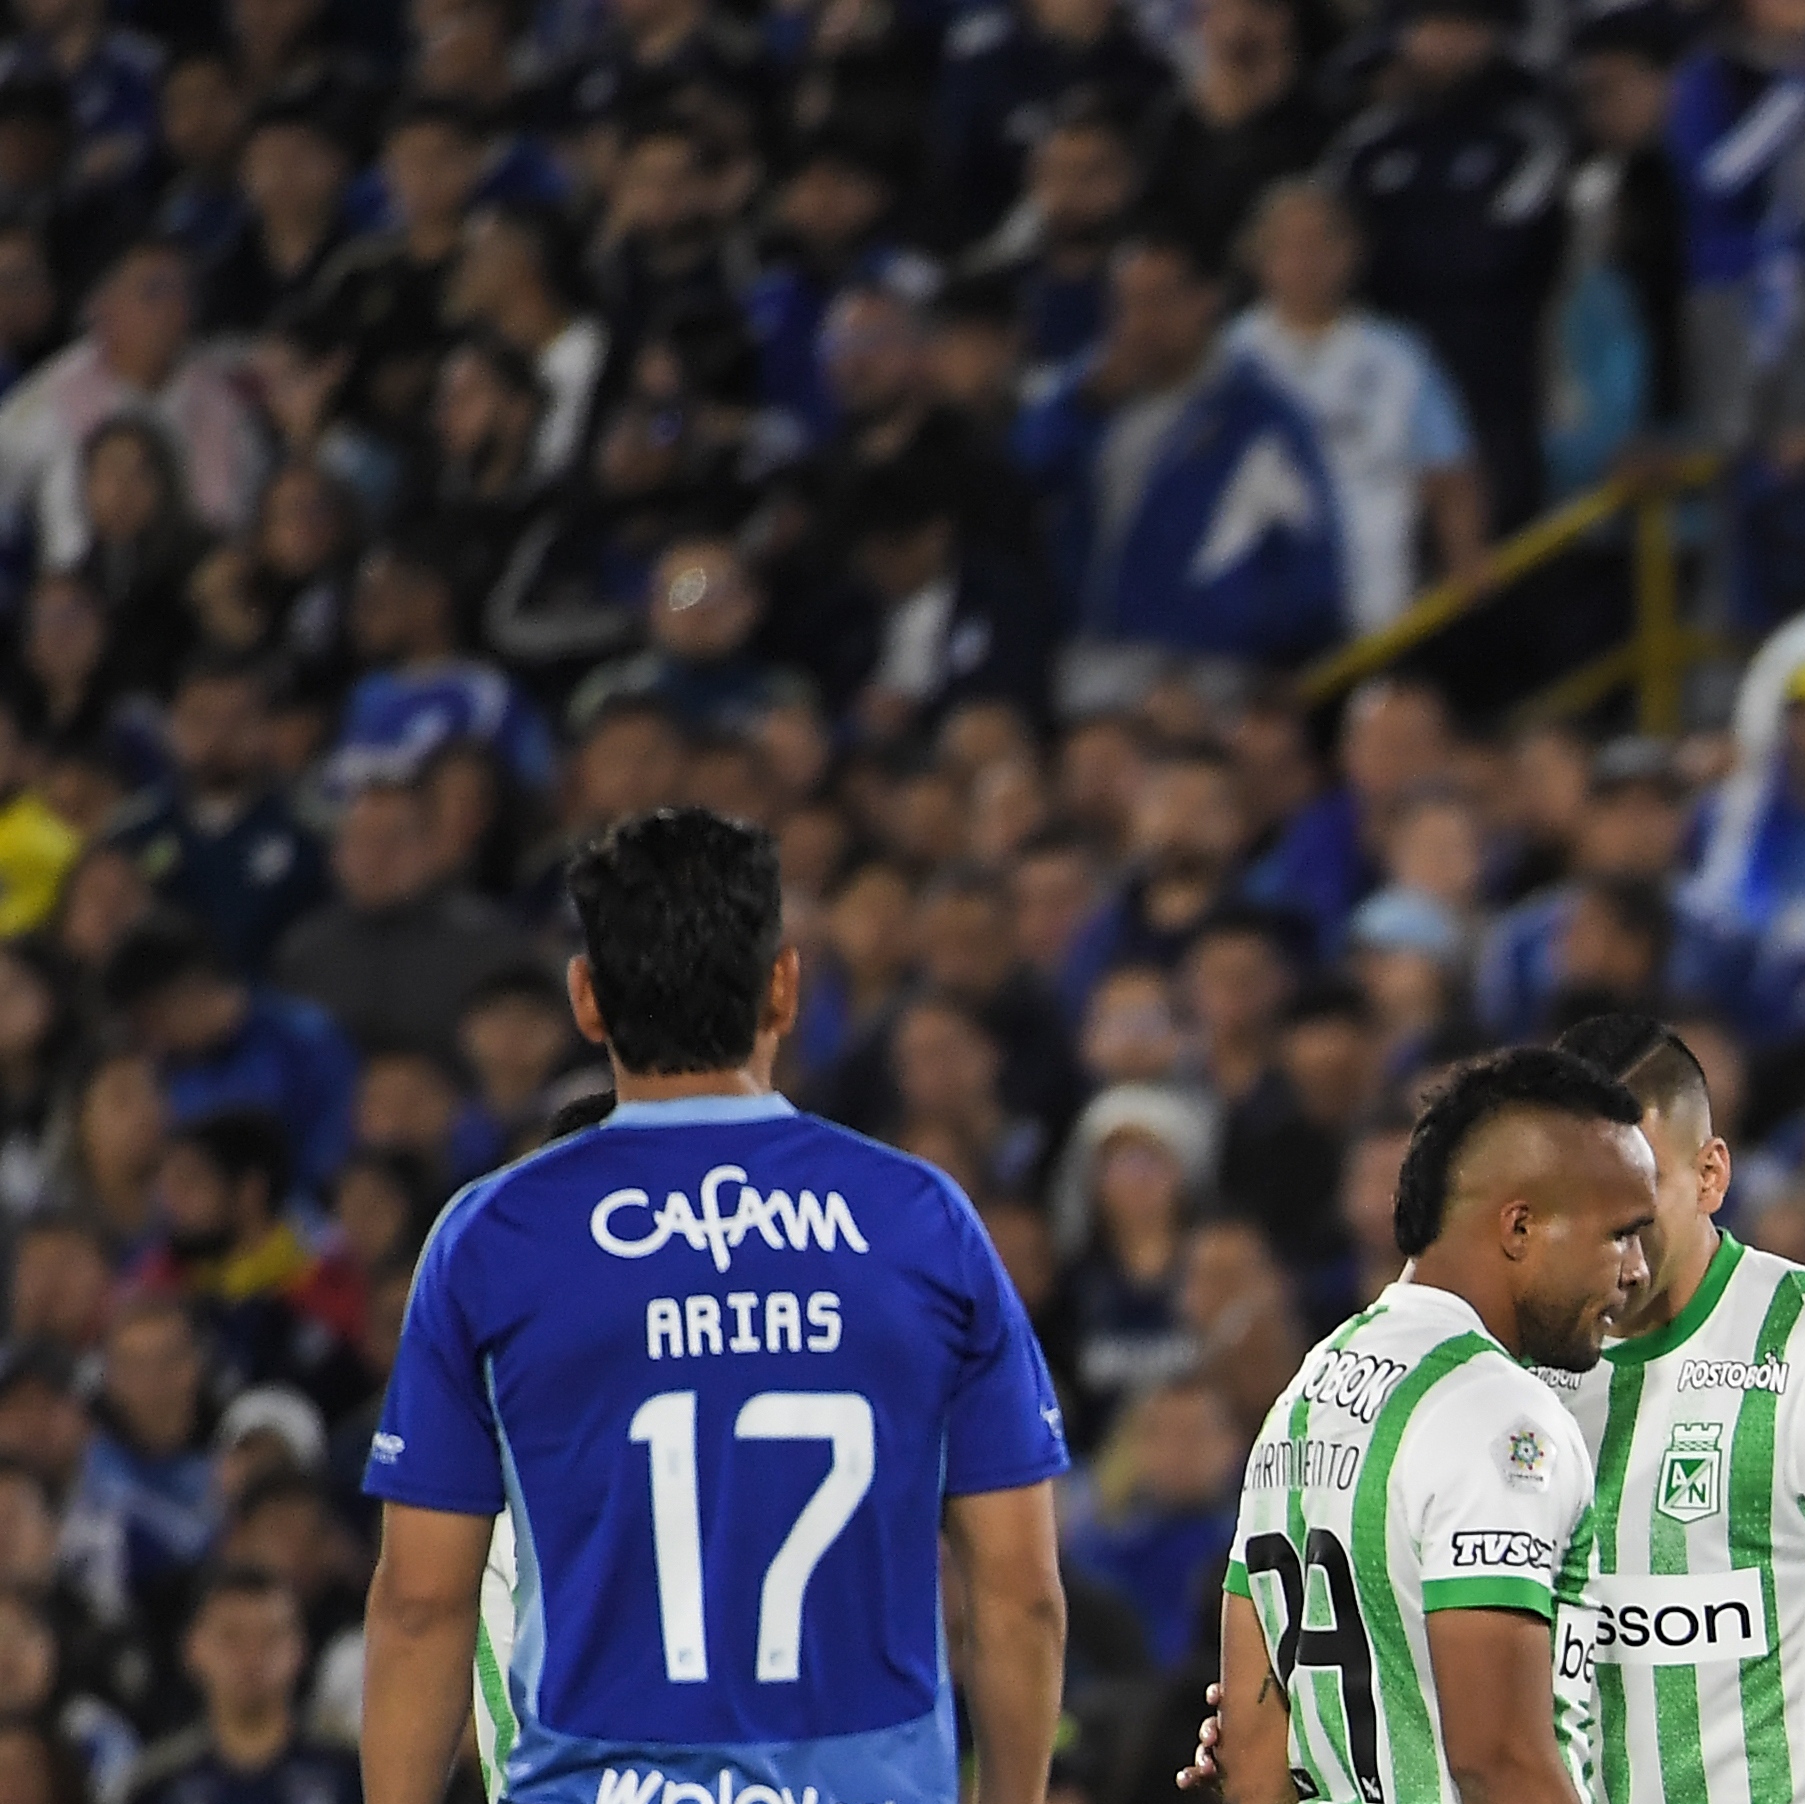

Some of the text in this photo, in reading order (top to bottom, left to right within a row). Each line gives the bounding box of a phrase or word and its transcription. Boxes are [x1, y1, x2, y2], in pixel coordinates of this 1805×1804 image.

[646, 1291, 842, 1360] ARIAS
[1244, 1439, 1359, 1491] ARMIENTO
[628, 1390, 875, 1684] 17
[1452, 1531, 1535, 1567] TVS
